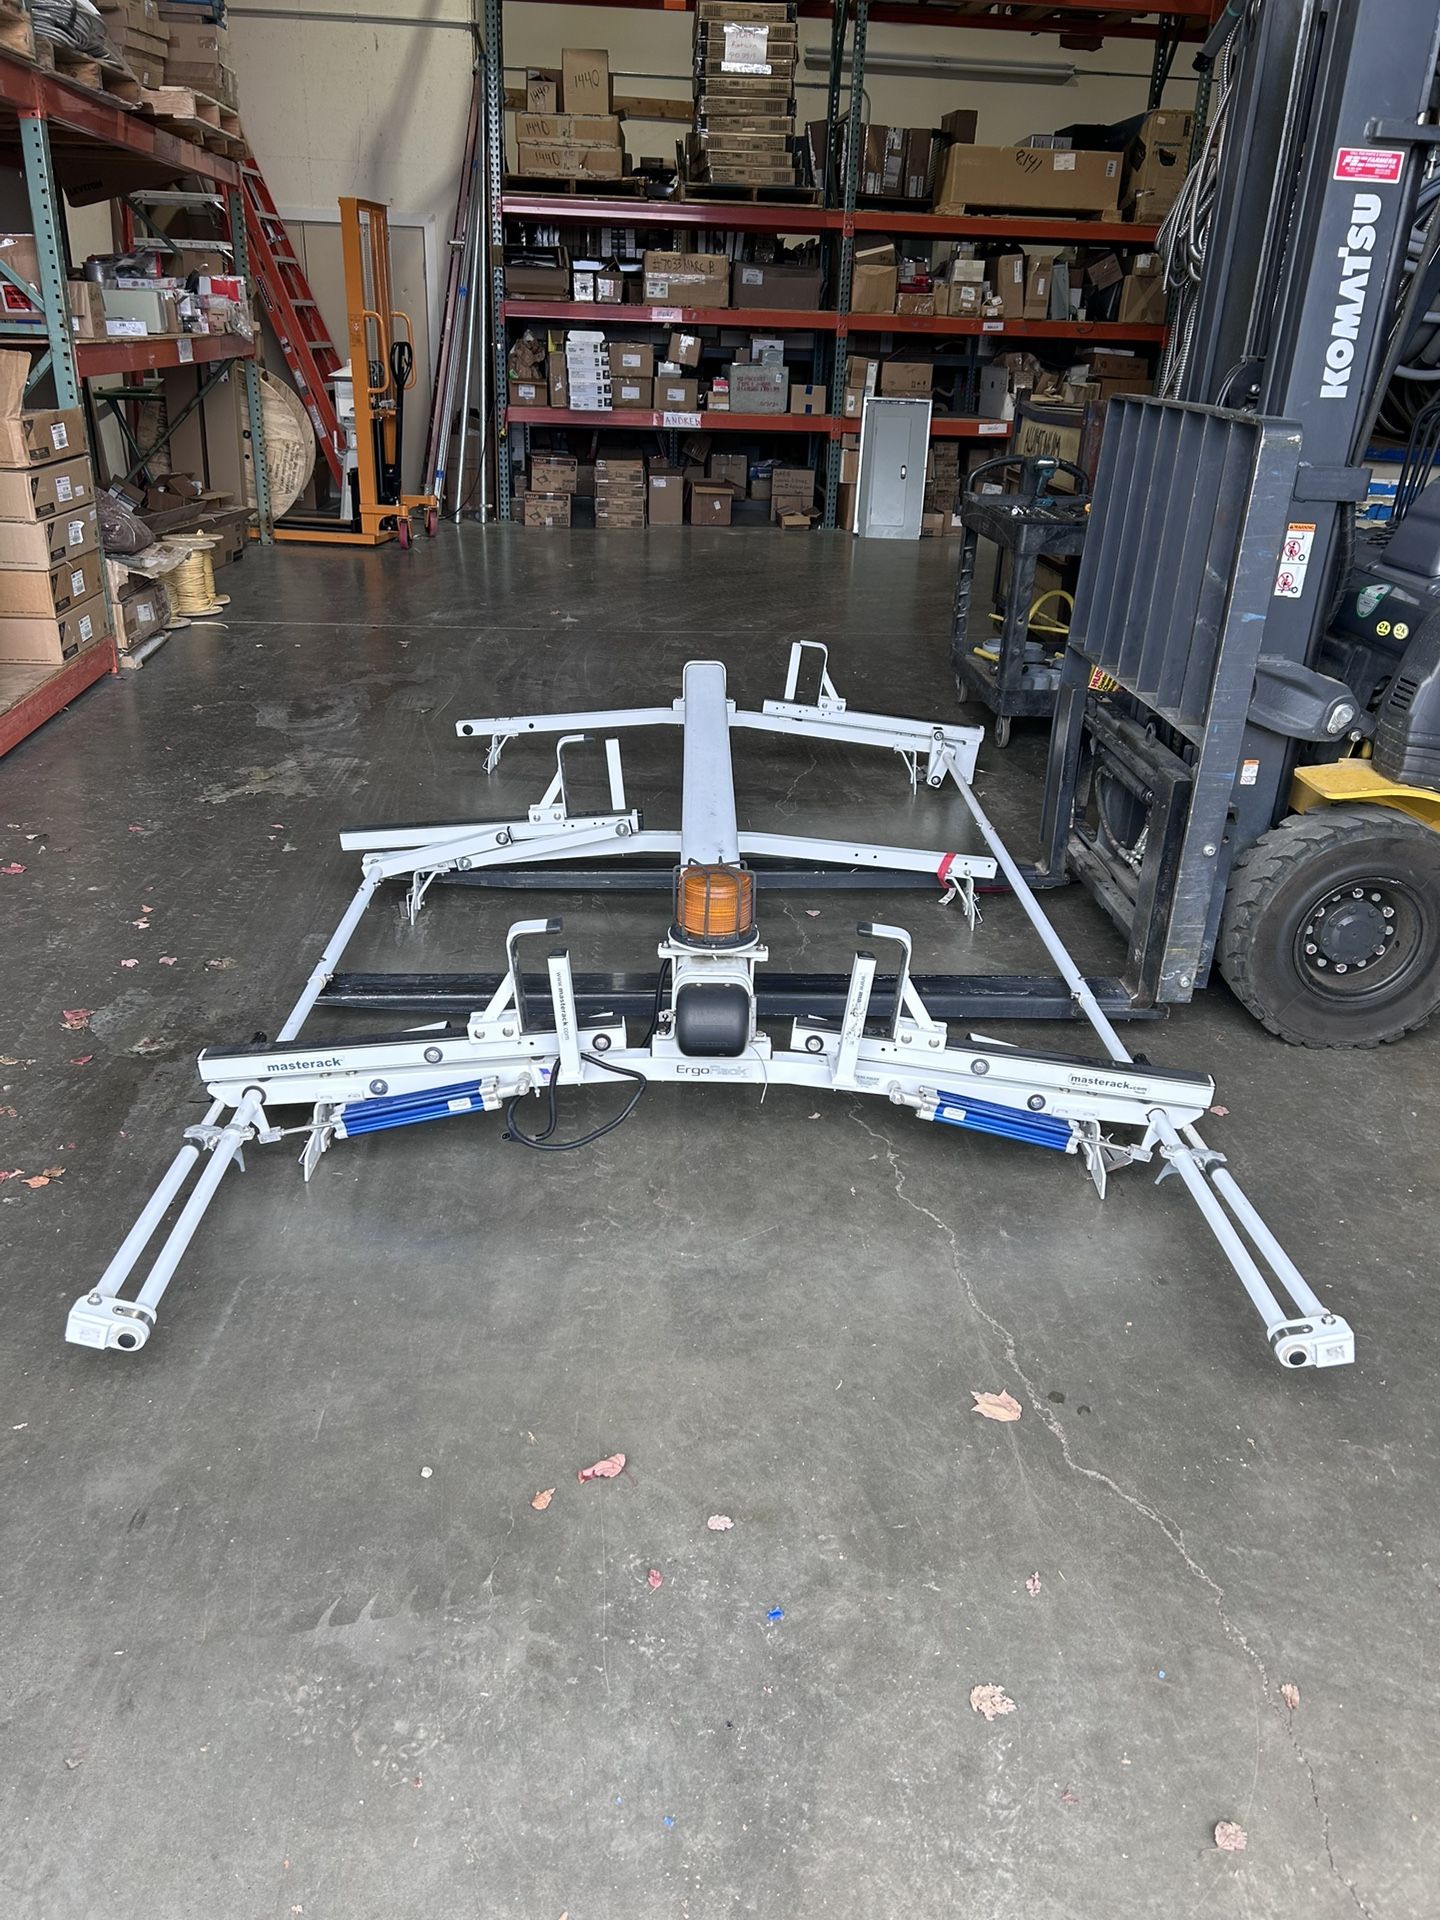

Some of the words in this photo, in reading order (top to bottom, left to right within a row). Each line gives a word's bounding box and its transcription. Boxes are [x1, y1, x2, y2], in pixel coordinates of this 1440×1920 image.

[574, 69, 601, 89] 1440
[530, 84, 551, 103] 1440
[526, 120, 550, 136] 1440
[535, 151, 560, 167] 1440
[1367, 157, 1398, 165] FARMERS
[1319, 193, 1383, 399] KOMATSU
[267, 1057, 342, 1072] masterack
[1070, 1075, 1148, 1093] masterack.com
